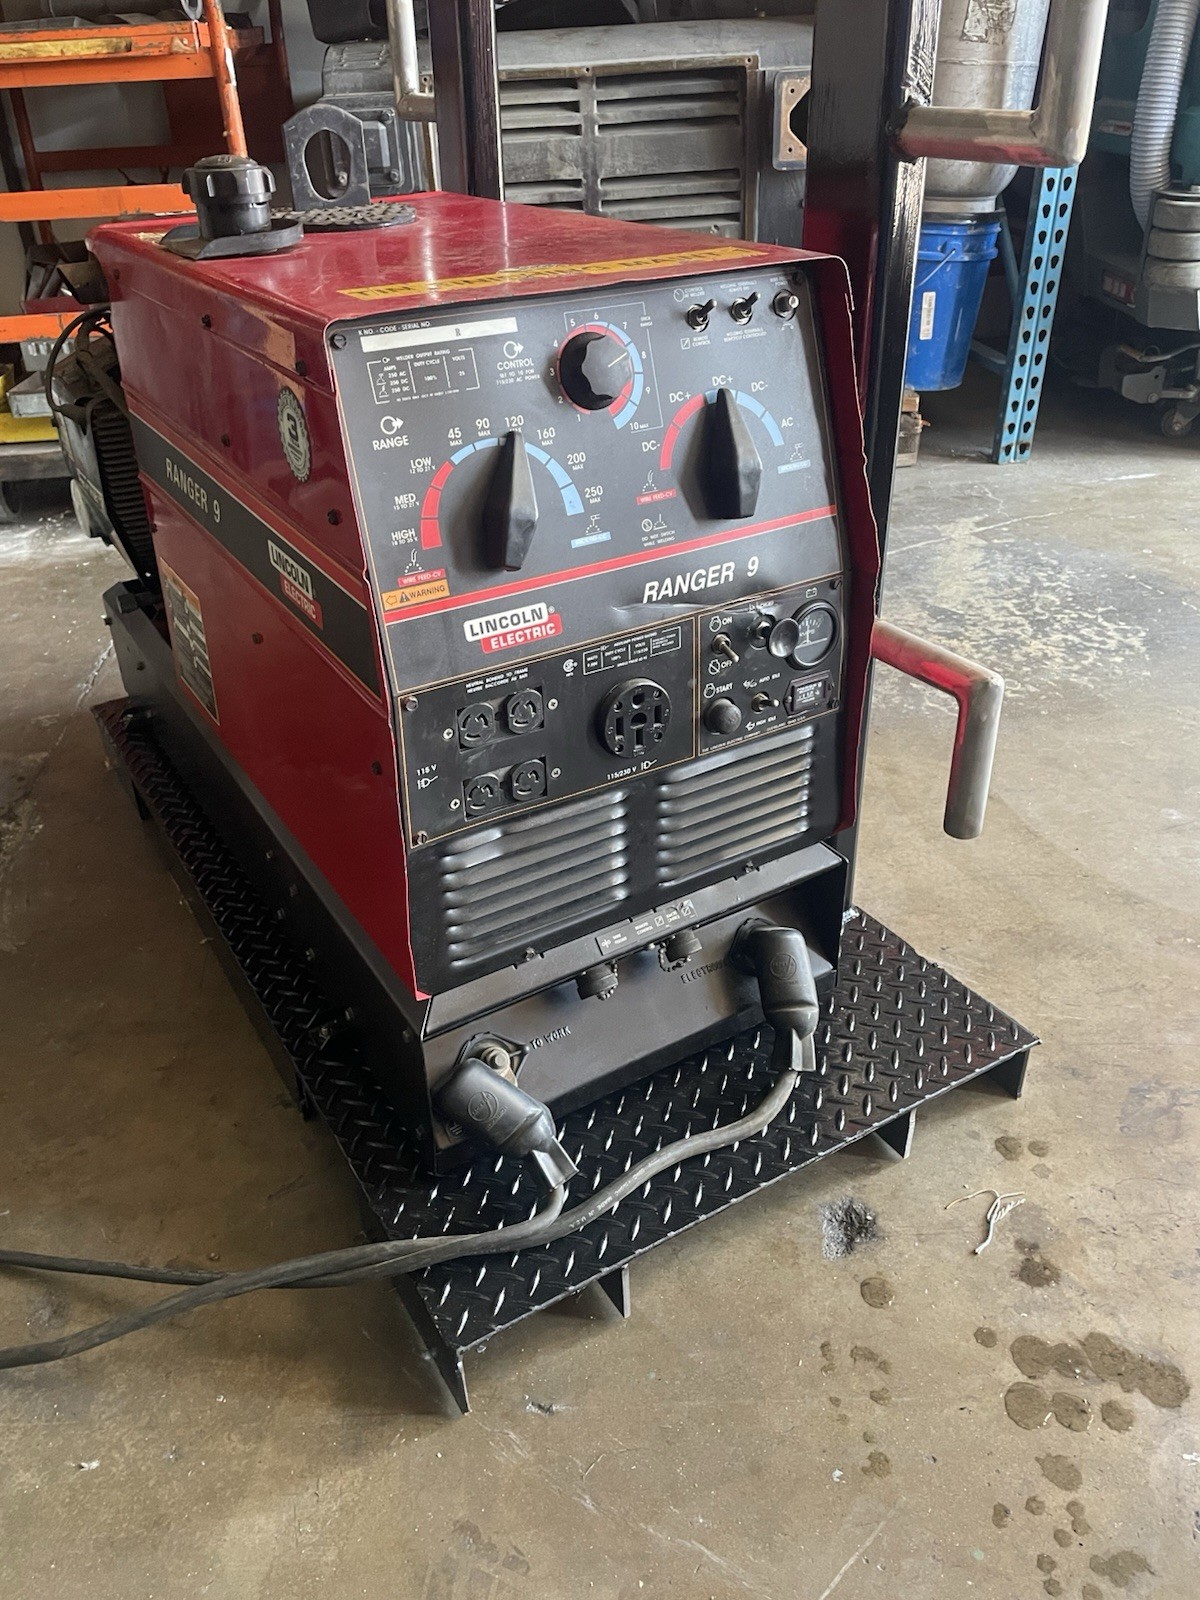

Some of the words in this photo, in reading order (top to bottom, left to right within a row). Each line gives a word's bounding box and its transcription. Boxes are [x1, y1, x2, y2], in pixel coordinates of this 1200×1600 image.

[594, 312, 599, 320] 6
[622, 322, 628, 330] 7
[553, 340, 558, 348] 4
[642, 350, 647, 359] 8
[497, 358, 534, 370] CONTROL
[550, 368, 555, 376] 3
[712, 375, 734, 386] DC+
[751, 380, 768, 392] DC-
[646, 386, 650, 394] 9
[558, 396, 563, 404] 2
[669, 392, 692, 403] DC+
[476, 418, 490, 429] 90
[505, 415, 524, 427] 120
[577, 414, 581, 422] 1
[780, 417, 794, 428] AC
[286, 410, 299, 440] 3
[629, 422, 639, 431] 10
[448, 427, 462, 439] 45
[478, 429, 491, 437] MAX
[536, 427, 556, 440] 160
[372, 435, 409, 451] RANGE
[450, 438, 462, 446] MAX
[541, 437, 553, 446] MAX
[642, 440, 660, 452] DC-
[410, 456, 432, 469] LOW
[567, 452, 586, 465] 200
[572, 463, 584, 471] MAX
[165, 457, 209, 514] RANGER
[213, 499, 221, 524] 9
[585, 485, 603, 498] 250
[394, 493, 416, 505] MED
[590, 496, 601, 504] MAX
[391, 528, 416, 541] HIGH
[272, 546, 310, 592] LINCOLN
[401, 576, 416, 584] WIRE
[417, 570, 442, 581] FEED-CV
[643, 562, 735, 604] RANGER
[746, 556, 760, 577] 9
[409, 584, 446, 598] WARNING
[284, 578, 316, 620] ELECTRIC
[469, 606, 544, 637] LINCOLN
[722, 616, 733, 626] ON
[490, 623, 556, 650] ELECTRIC
[716, 682, 733, 694] START
[416, 766, 429, 776] 115
[431, 764, 436, 772] V
[607, 769, 631, 780] 115/230
[530, 1037, 543, 1050] TO
[544, 1025, 572, 1047] WORK
[597, 1196, 612, 1211] MADE
